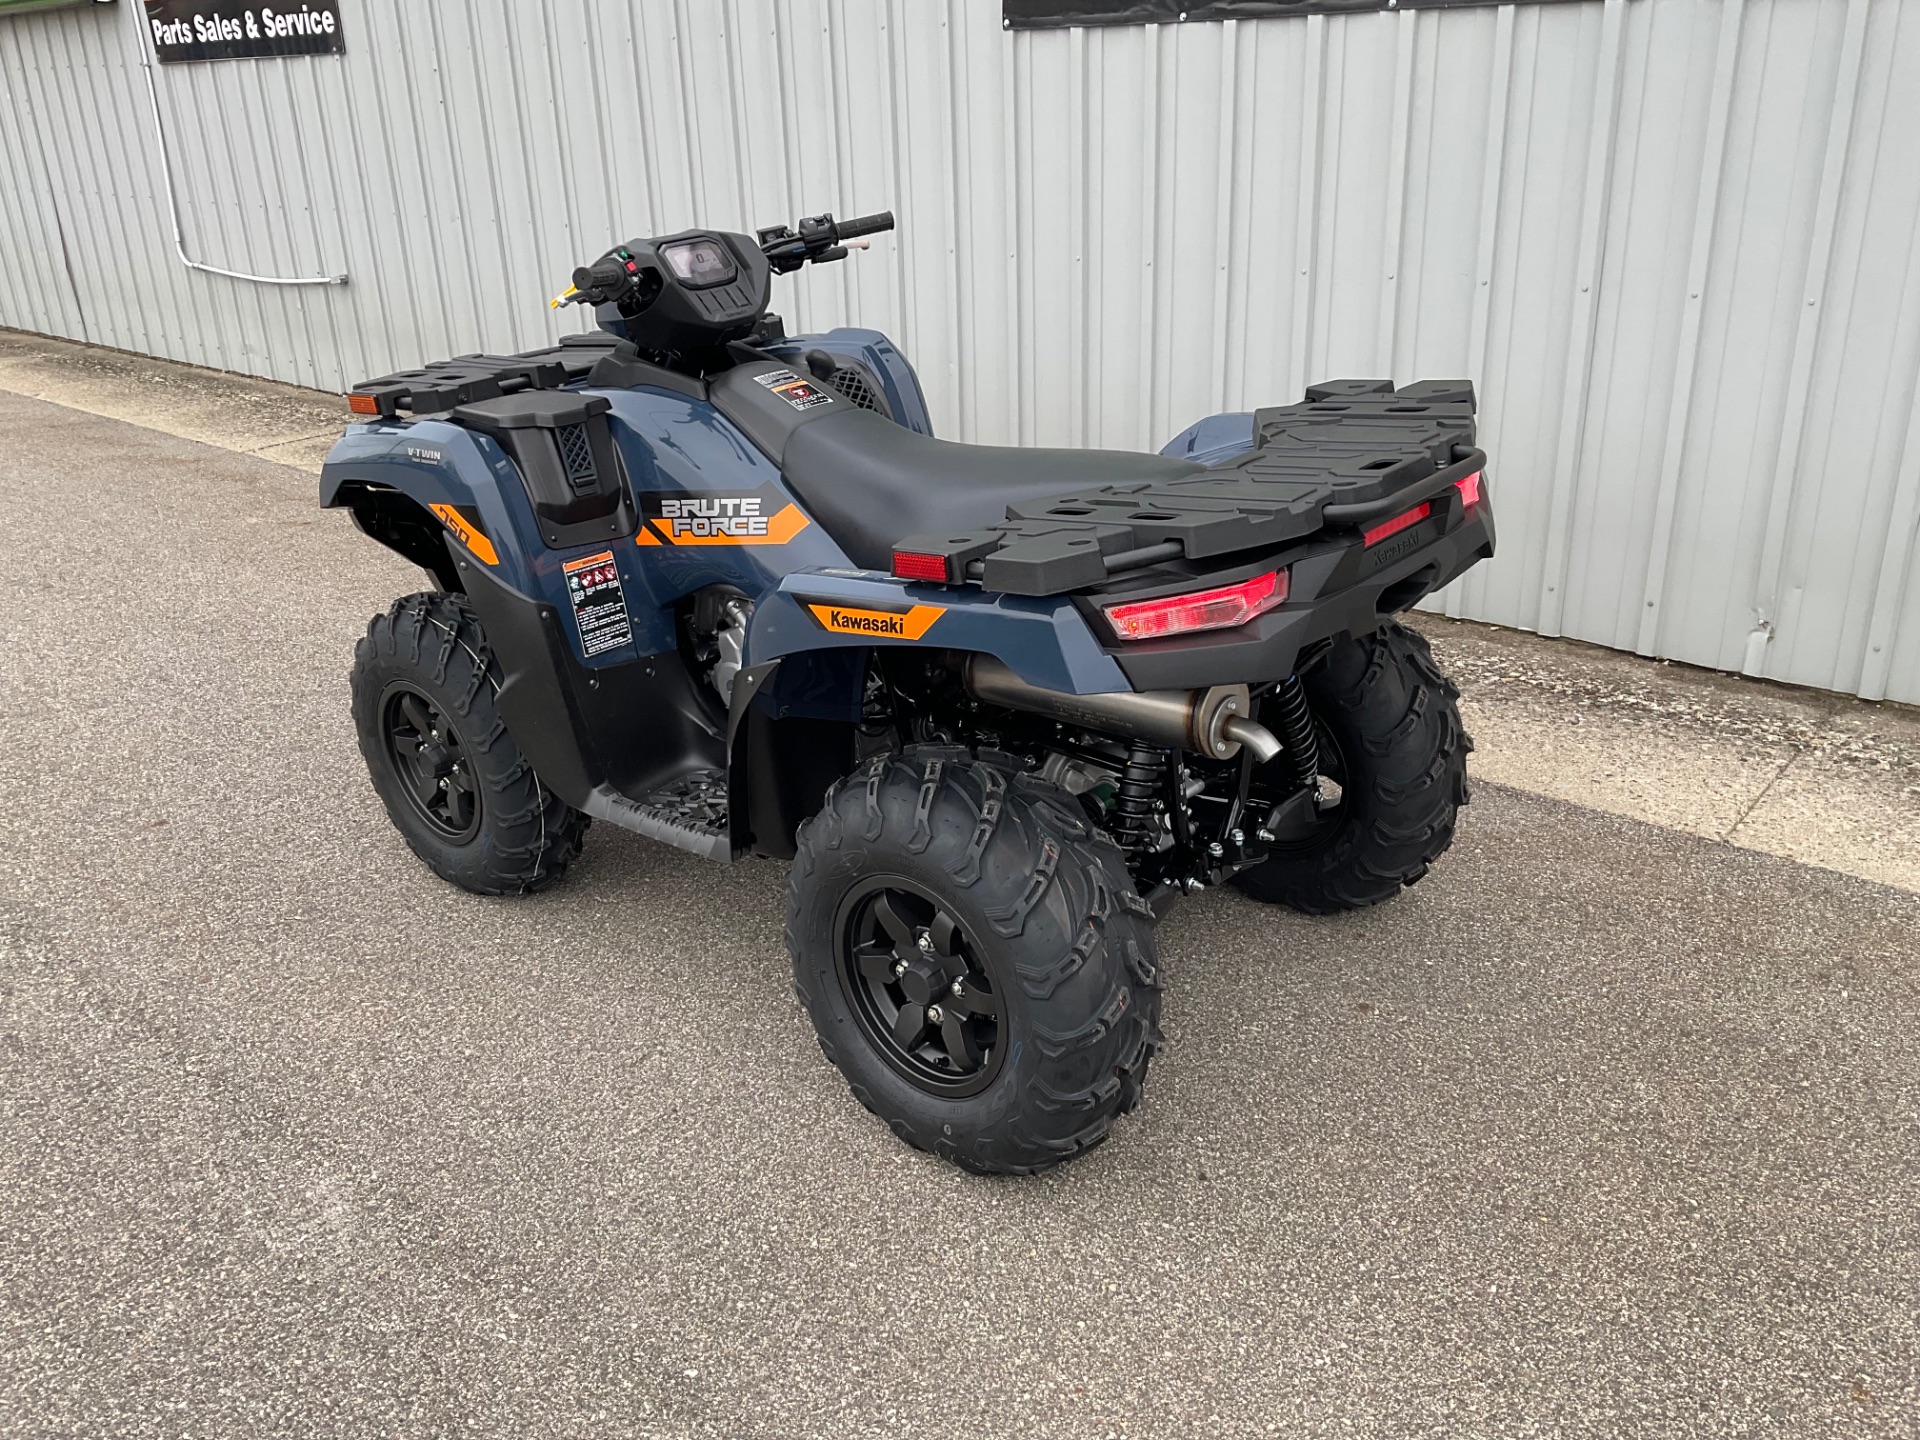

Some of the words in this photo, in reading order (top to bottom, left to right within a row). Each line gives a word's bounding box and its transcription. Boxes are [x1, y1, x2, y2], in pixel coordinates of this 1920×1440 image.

[151, 18, 193, 45] Parts
[194, 13, 242, 43] Sales
[244, 10, 260, 39] &
[262, 4, 335, 38] Service
[407, 447, 441, 460] V-TWIN
[661, 498, 762, 518] BRUTE
[439, 506, 470, 546] 750
[673, 517, 769, 537] FORCE
[830, 610, 904, 634] Kawasaki
